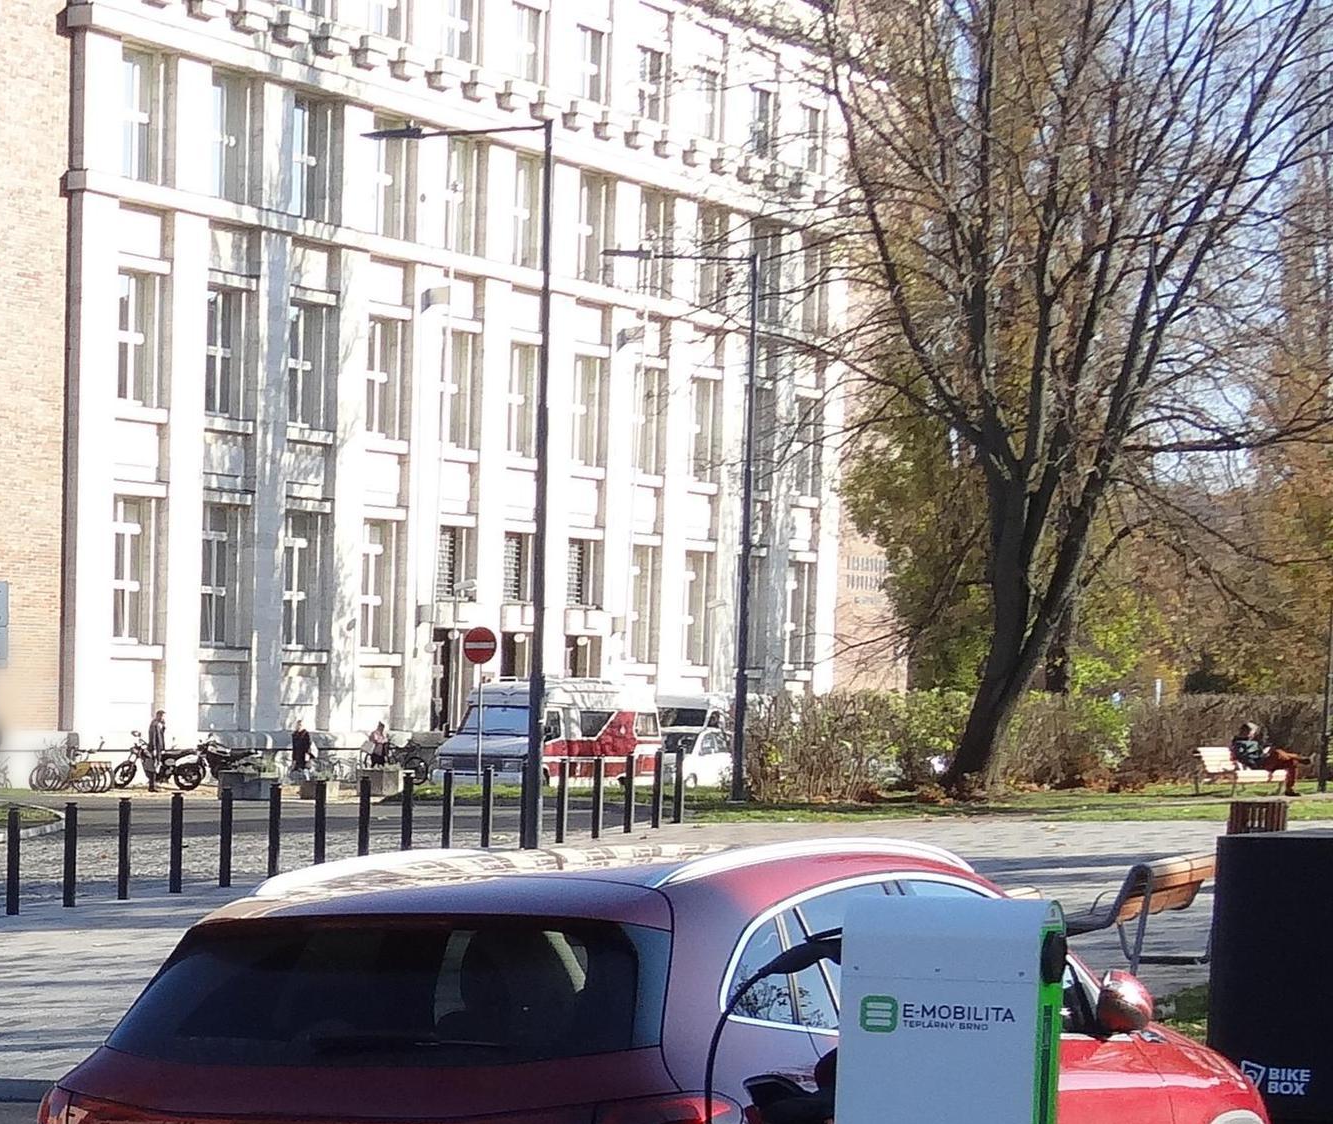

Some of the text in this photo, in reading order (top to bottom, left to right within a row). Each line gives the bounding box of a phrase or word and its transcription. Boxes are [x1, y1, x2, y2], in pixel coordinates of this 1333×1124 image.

[903, 1003, 1016, 1022] E-MOBILITA
[959, 1022, 989, 1031] BRNO
[1268, 1068, 1311, 1082] BIKE
[1267, 1081, 1306, 1096] BOX
